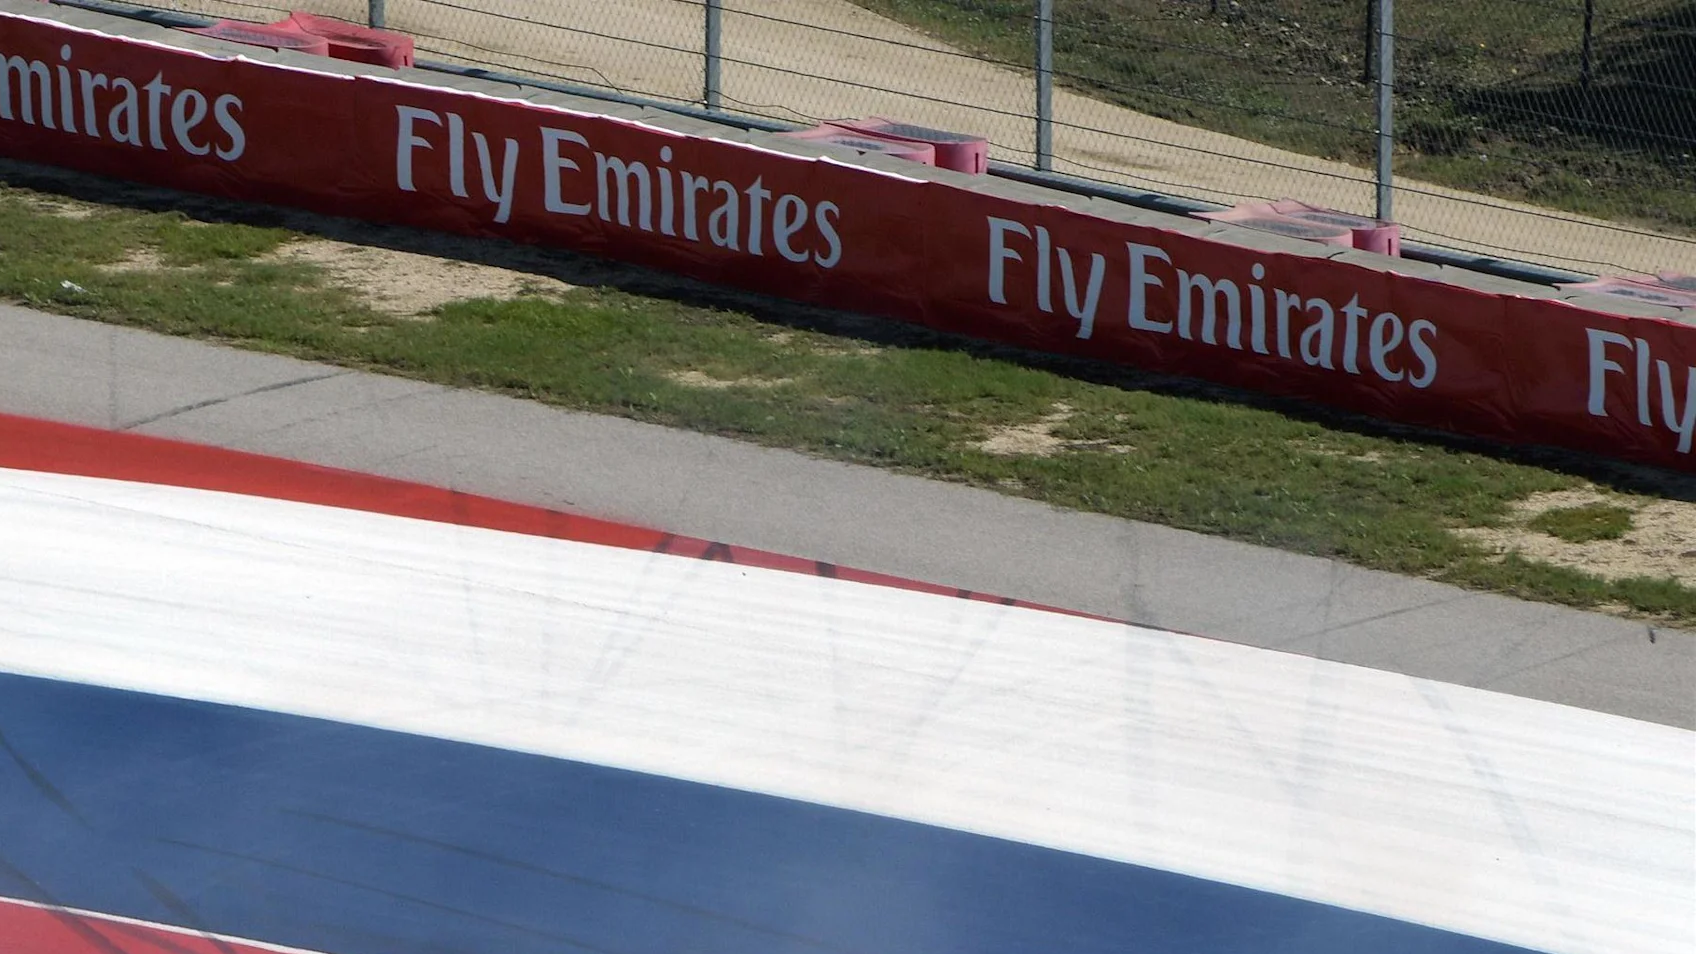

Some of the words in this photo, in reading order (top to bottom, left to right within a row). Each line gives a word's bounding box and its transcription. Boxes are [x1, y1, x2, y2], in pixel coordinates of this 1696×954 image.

[396, 105, 519, 224] Fly
[541, 126, 842, 269] Emirates
[987, 216, 1106, 339] Fly
[1128, 242, 1437, 388] Emirates
[1585, 327, 1696, 454] Fly
